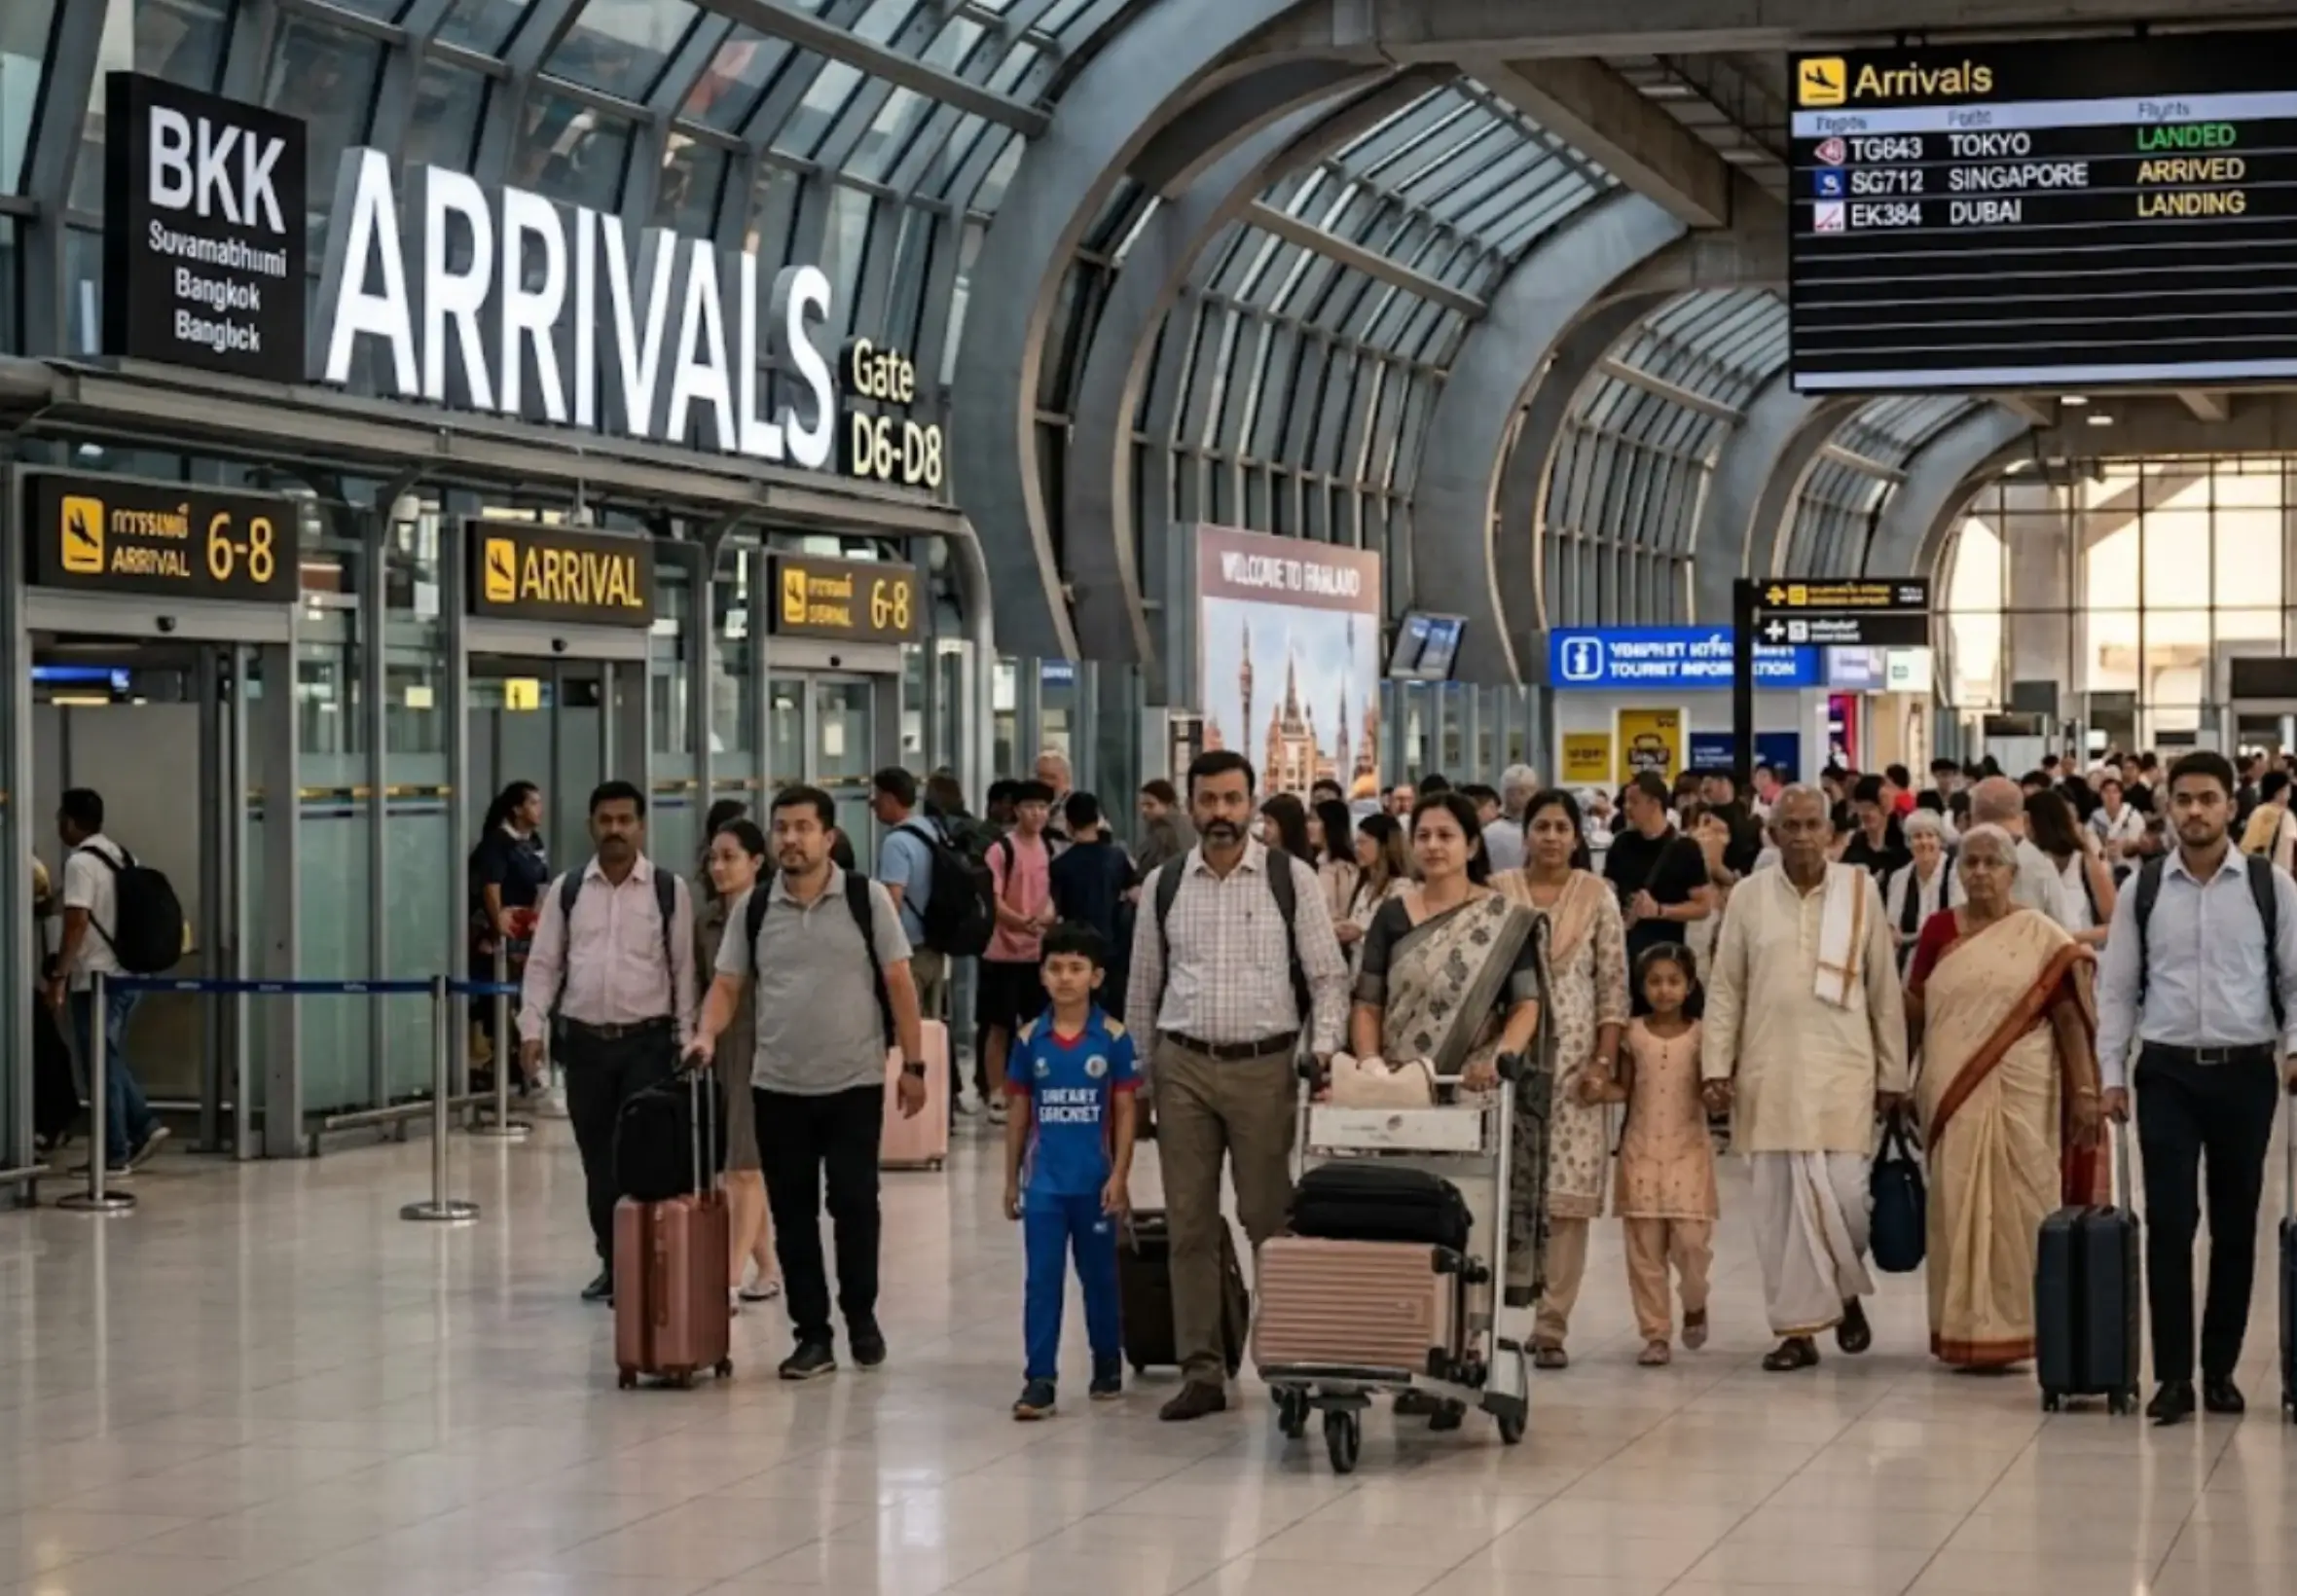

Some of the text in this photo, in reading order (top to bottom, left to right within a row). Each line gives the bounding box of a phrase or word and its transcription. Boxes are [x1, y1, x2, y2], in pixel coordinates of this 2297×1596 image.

[1853, 59, 1993, 97] Arrivals
[1949, 132, 2031, 158] TOKYO
[2137, 124, 2237, 151] LANDED
[149, 104, 287, 235] BKK
[1850, 158, 2245, 194] SG712 SINGAPORE ARRIVED
[1851, 190, 2245, 227] EK384 DUBAI LANDING
[174, 267, 261, 312] Bangkok
[324, 148, 834, 469] ARRIVALS
[854, 338, 915, 403] Gate
[853, 410, 942, 487] D6-D8
[111, 545, 191, 577] ARRIVAL
[207, 512, 273, 583] 6-8
[520, 546, 643, 607] ARRIVAL
[871, 578, 909, 629] 6-8
